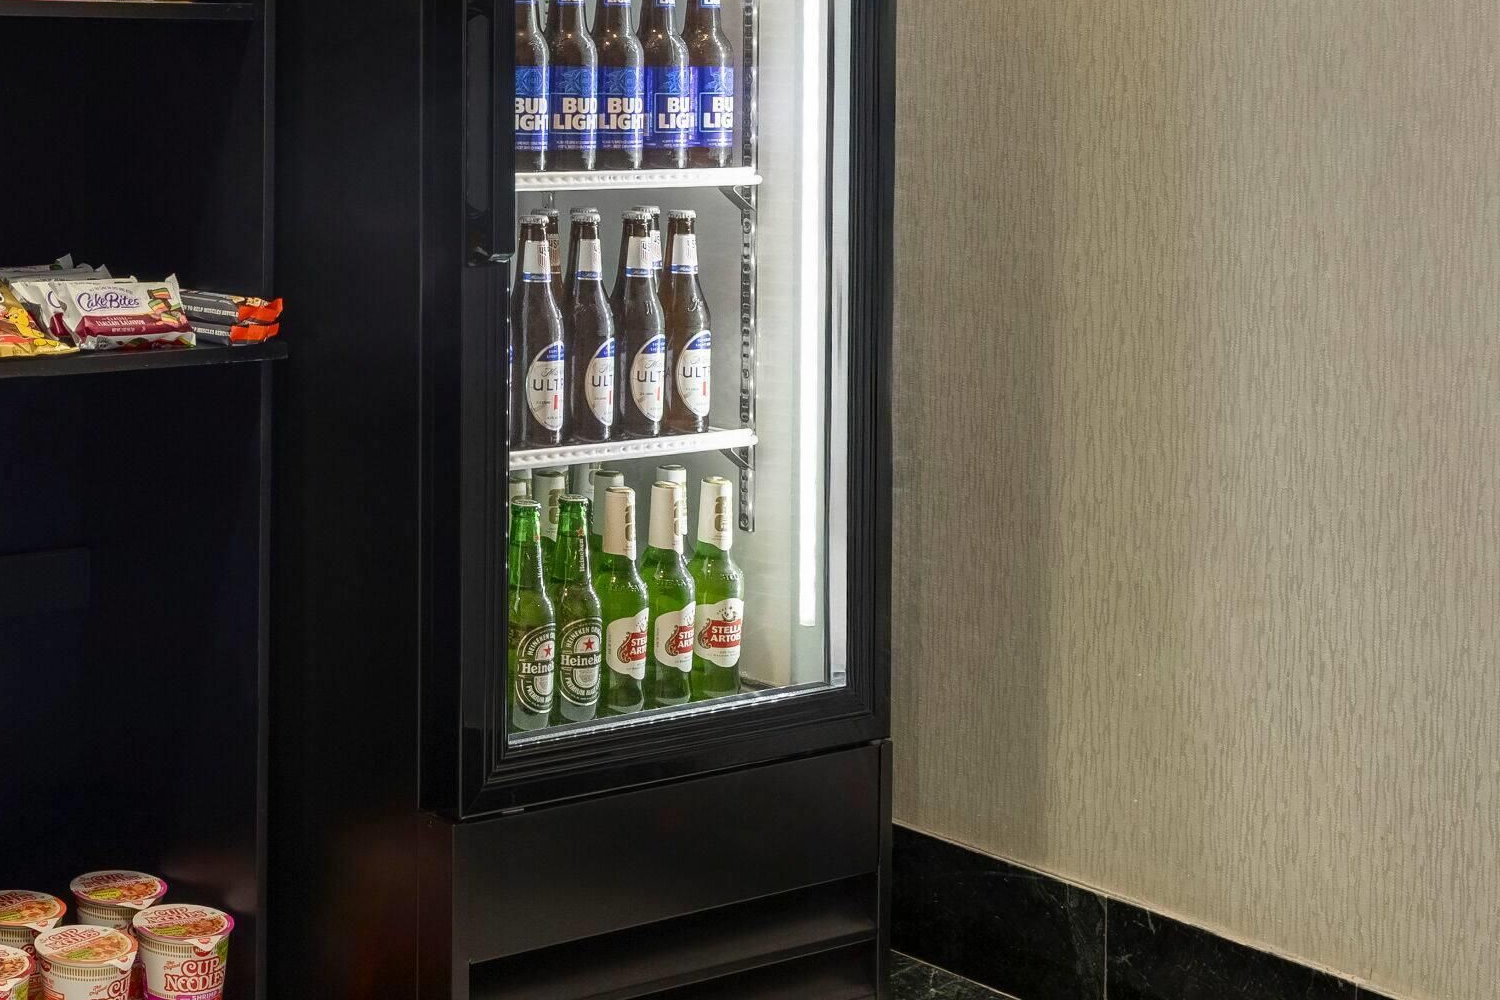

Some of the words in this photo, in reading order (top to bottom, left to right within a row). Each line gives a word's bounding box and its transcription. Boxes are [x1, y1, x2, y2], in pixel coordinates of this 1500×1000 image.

[563, 98, 597, 113] BUD
[608, 98, 643, 113] BUD
[533, 378, 563, 391] ULTR
[561, 654, 601, 666] Heinek
[182, 957, 220, 976] CUP
